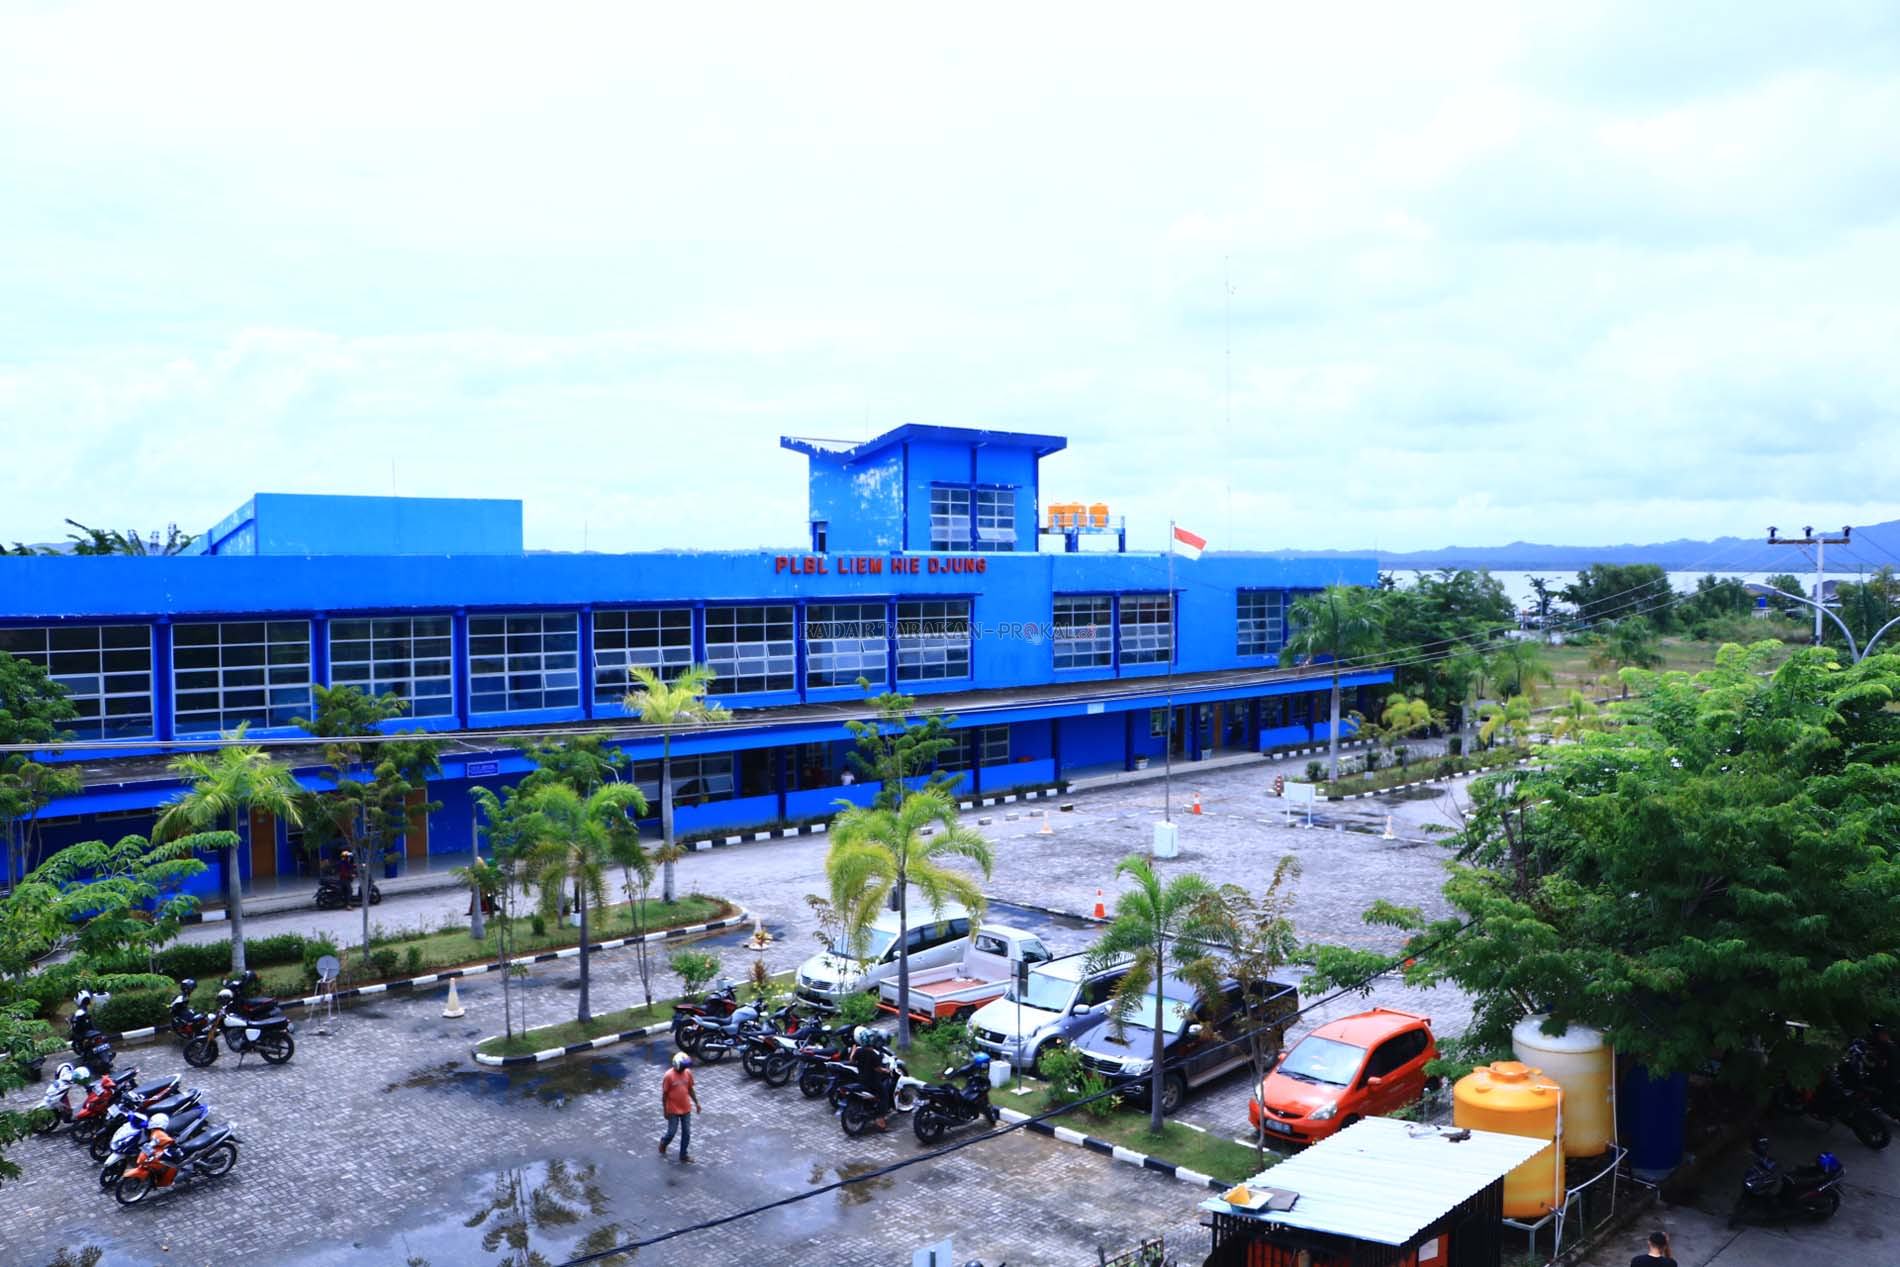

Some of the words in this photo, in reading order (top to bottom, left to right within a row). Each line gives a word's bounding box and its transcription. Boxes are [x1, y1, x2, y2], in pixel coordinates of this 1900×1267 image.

[776, 556, 828, 574] PLBL
[838, 556, 882, 574] LIEM
[891, 556, 919, 574] HIE
[927, 556, 986, 574] DJUNG
